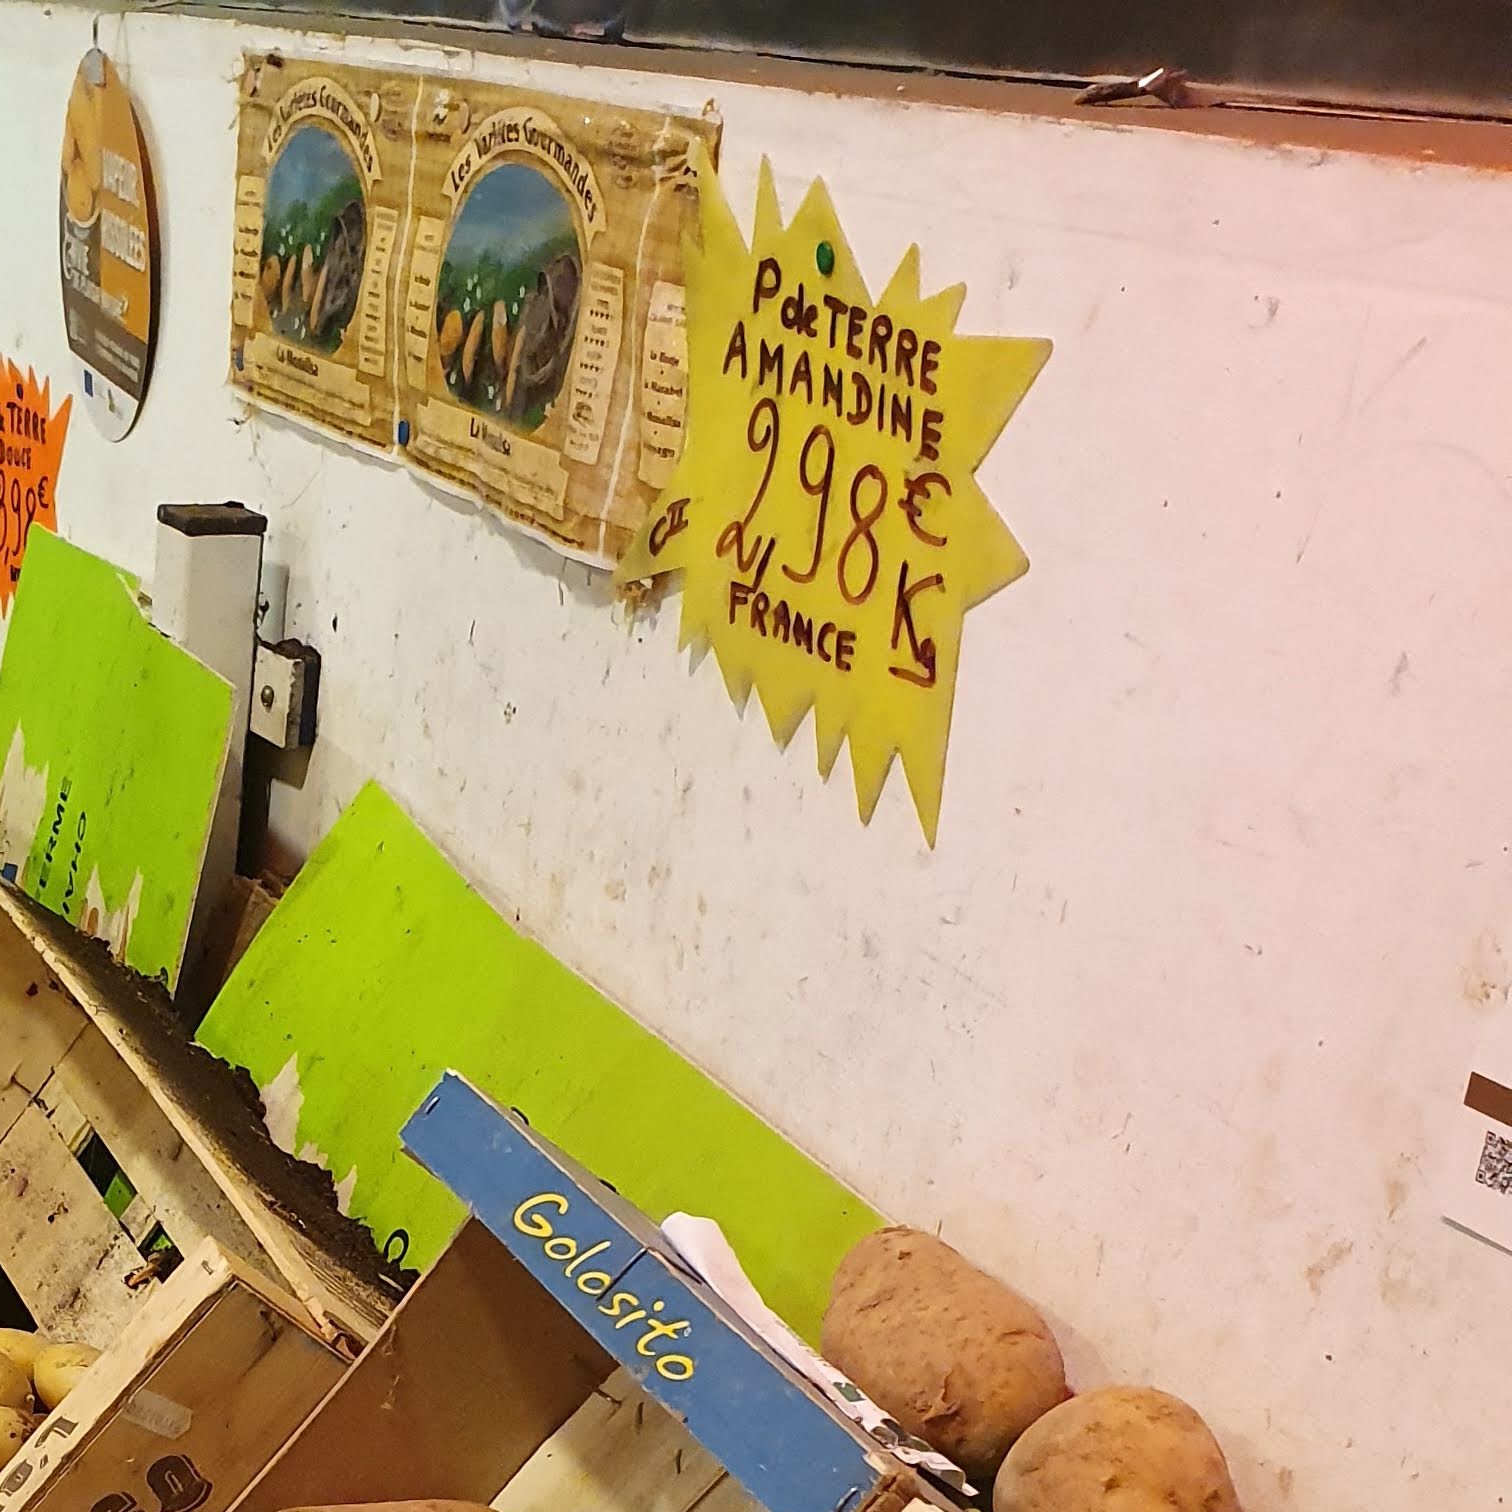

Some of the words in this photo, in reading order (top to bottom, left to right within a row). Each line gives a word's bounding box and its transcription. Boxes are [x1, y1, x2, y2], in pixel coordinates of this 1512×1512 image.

[451, 153, 472, 194] Les
[522, 116, 598, 223] Gourmandes
[752, 256, 783, 314] P
[780, 281, 819, 338] de
[823, 293, 942, 396] TERRE
[6, 401, 47, 446] TERRE
[722, 319, 945, 462] AMANDINE
[0, 437, 32, 470] DOUCE
[728, 580, 858, 672] FRANCE
[35, 775, 73, 900] ERME
[511, 1191, 696, 1382] Golosito
